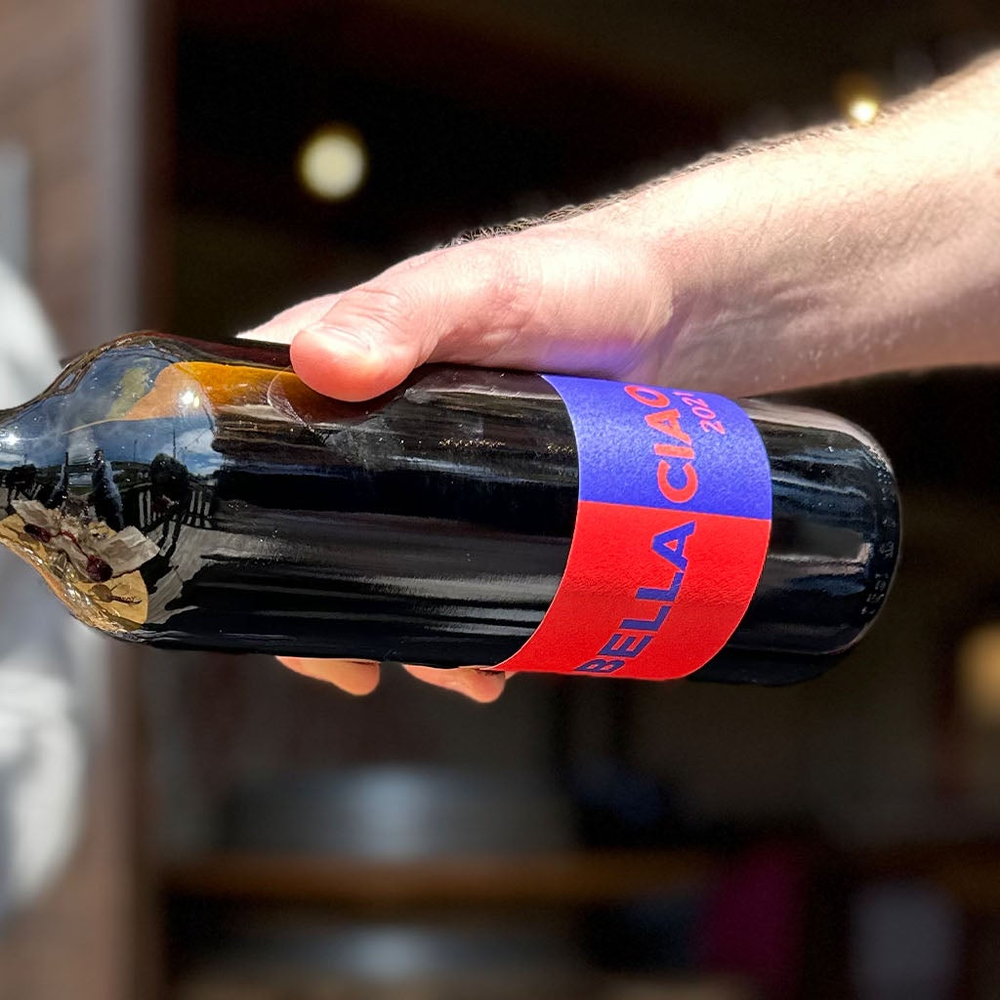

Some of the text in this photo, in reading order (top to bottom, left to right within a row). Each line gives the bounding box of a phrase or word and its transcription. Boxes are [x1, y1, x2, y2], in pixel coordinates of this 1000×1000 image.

[673, 391, 726, 435] 2021
[573, 385, 699, 674] BELLA CIAO
